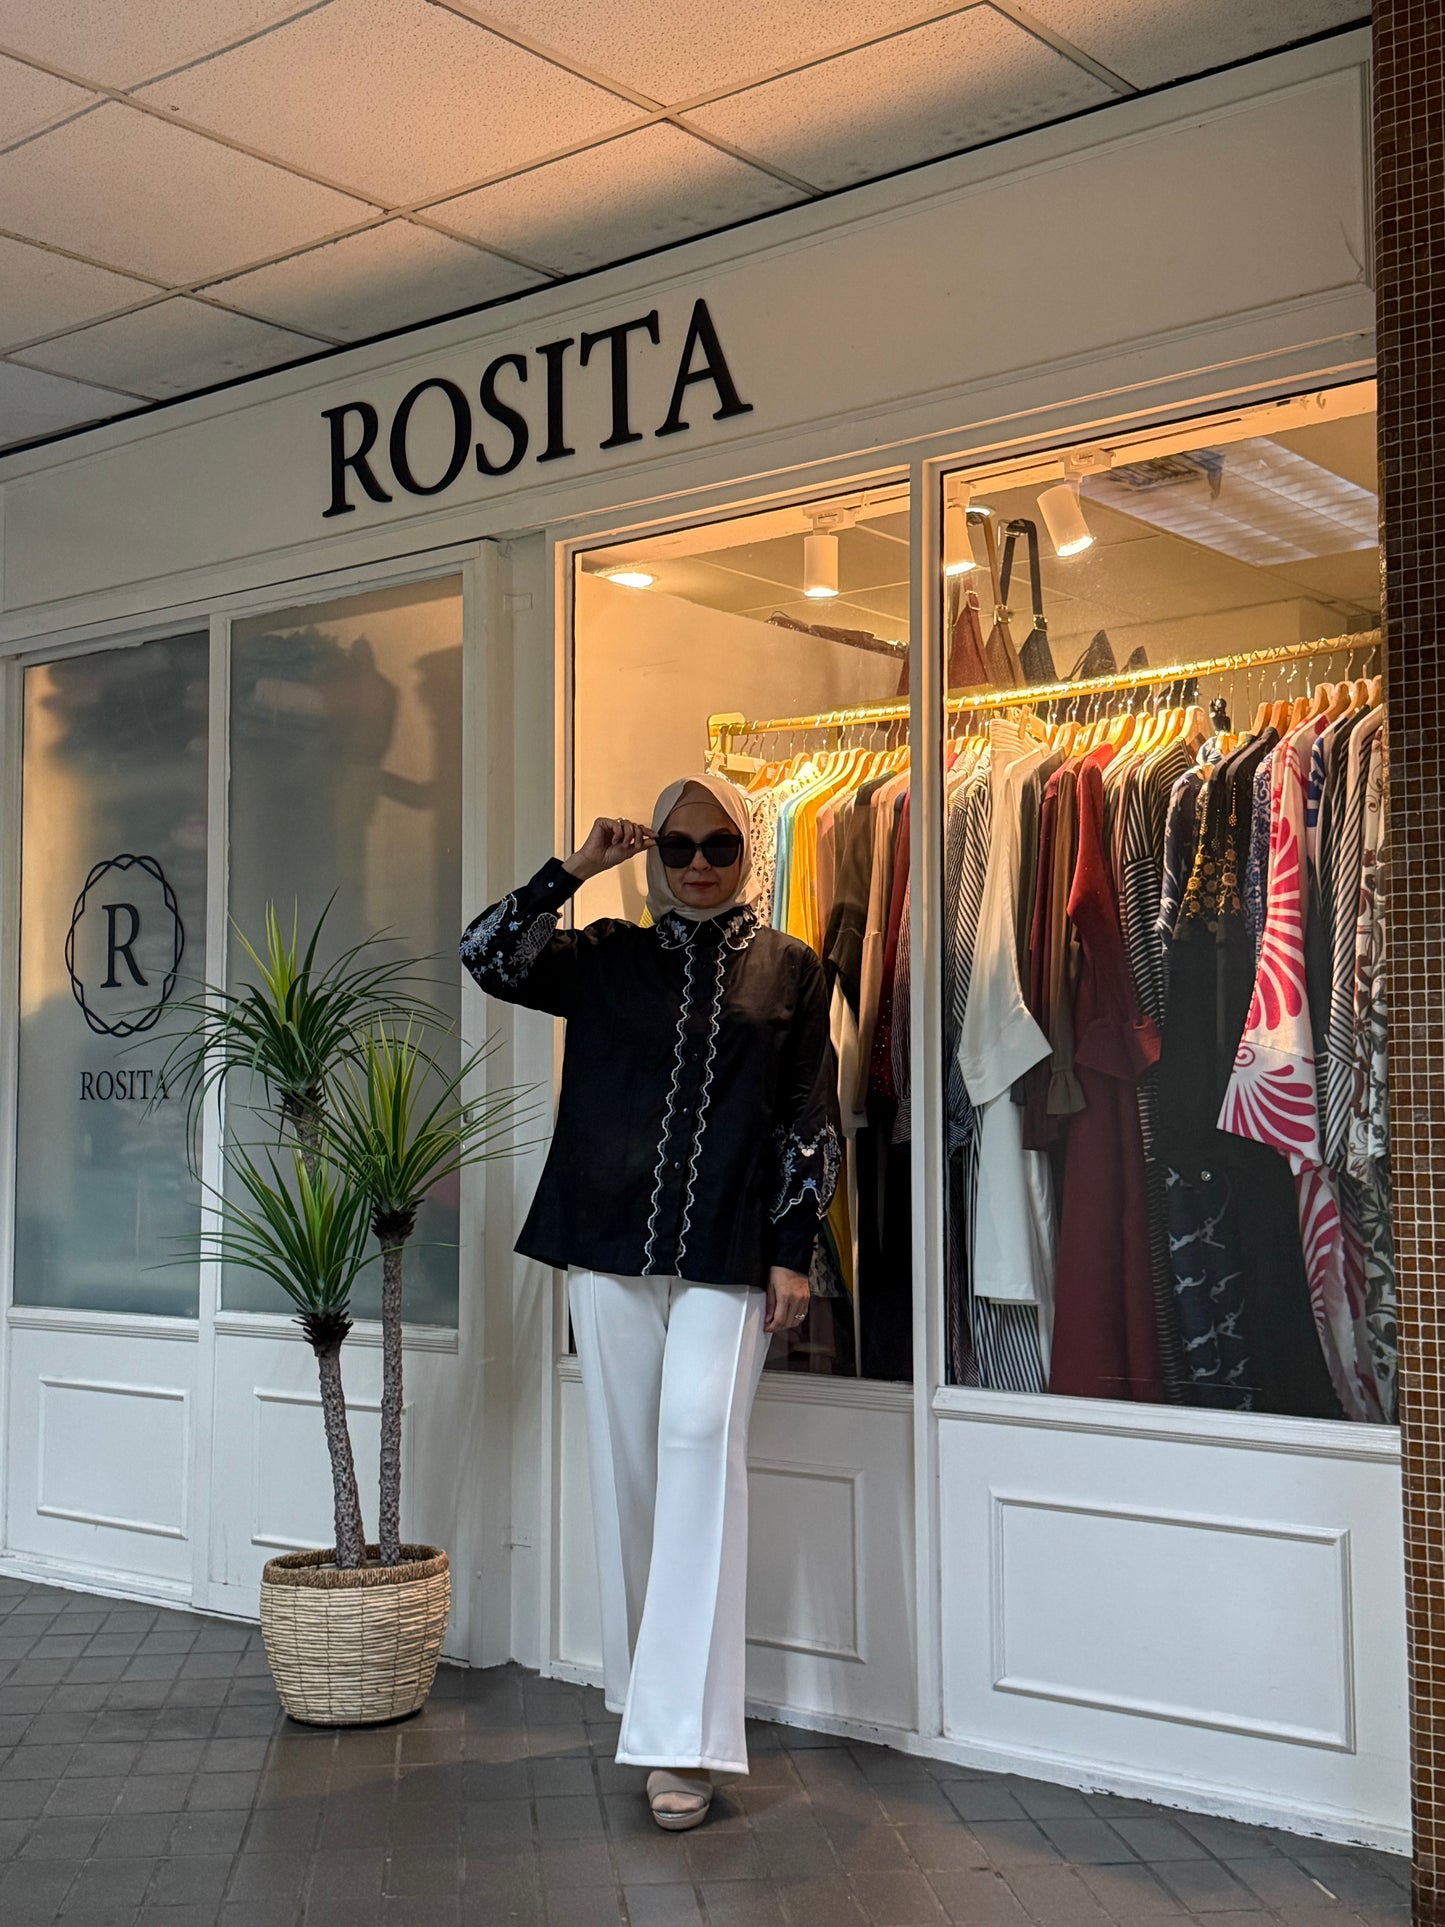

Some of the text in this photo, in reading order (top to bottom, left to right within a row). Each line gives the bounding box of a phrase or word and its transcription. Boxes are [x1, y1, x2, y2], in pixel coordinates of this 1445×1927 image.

[321, 298, 753, 518] ROSITA
[100, 903, 148, 988] R
[80, 1069, 170, 1101] ROSITA
